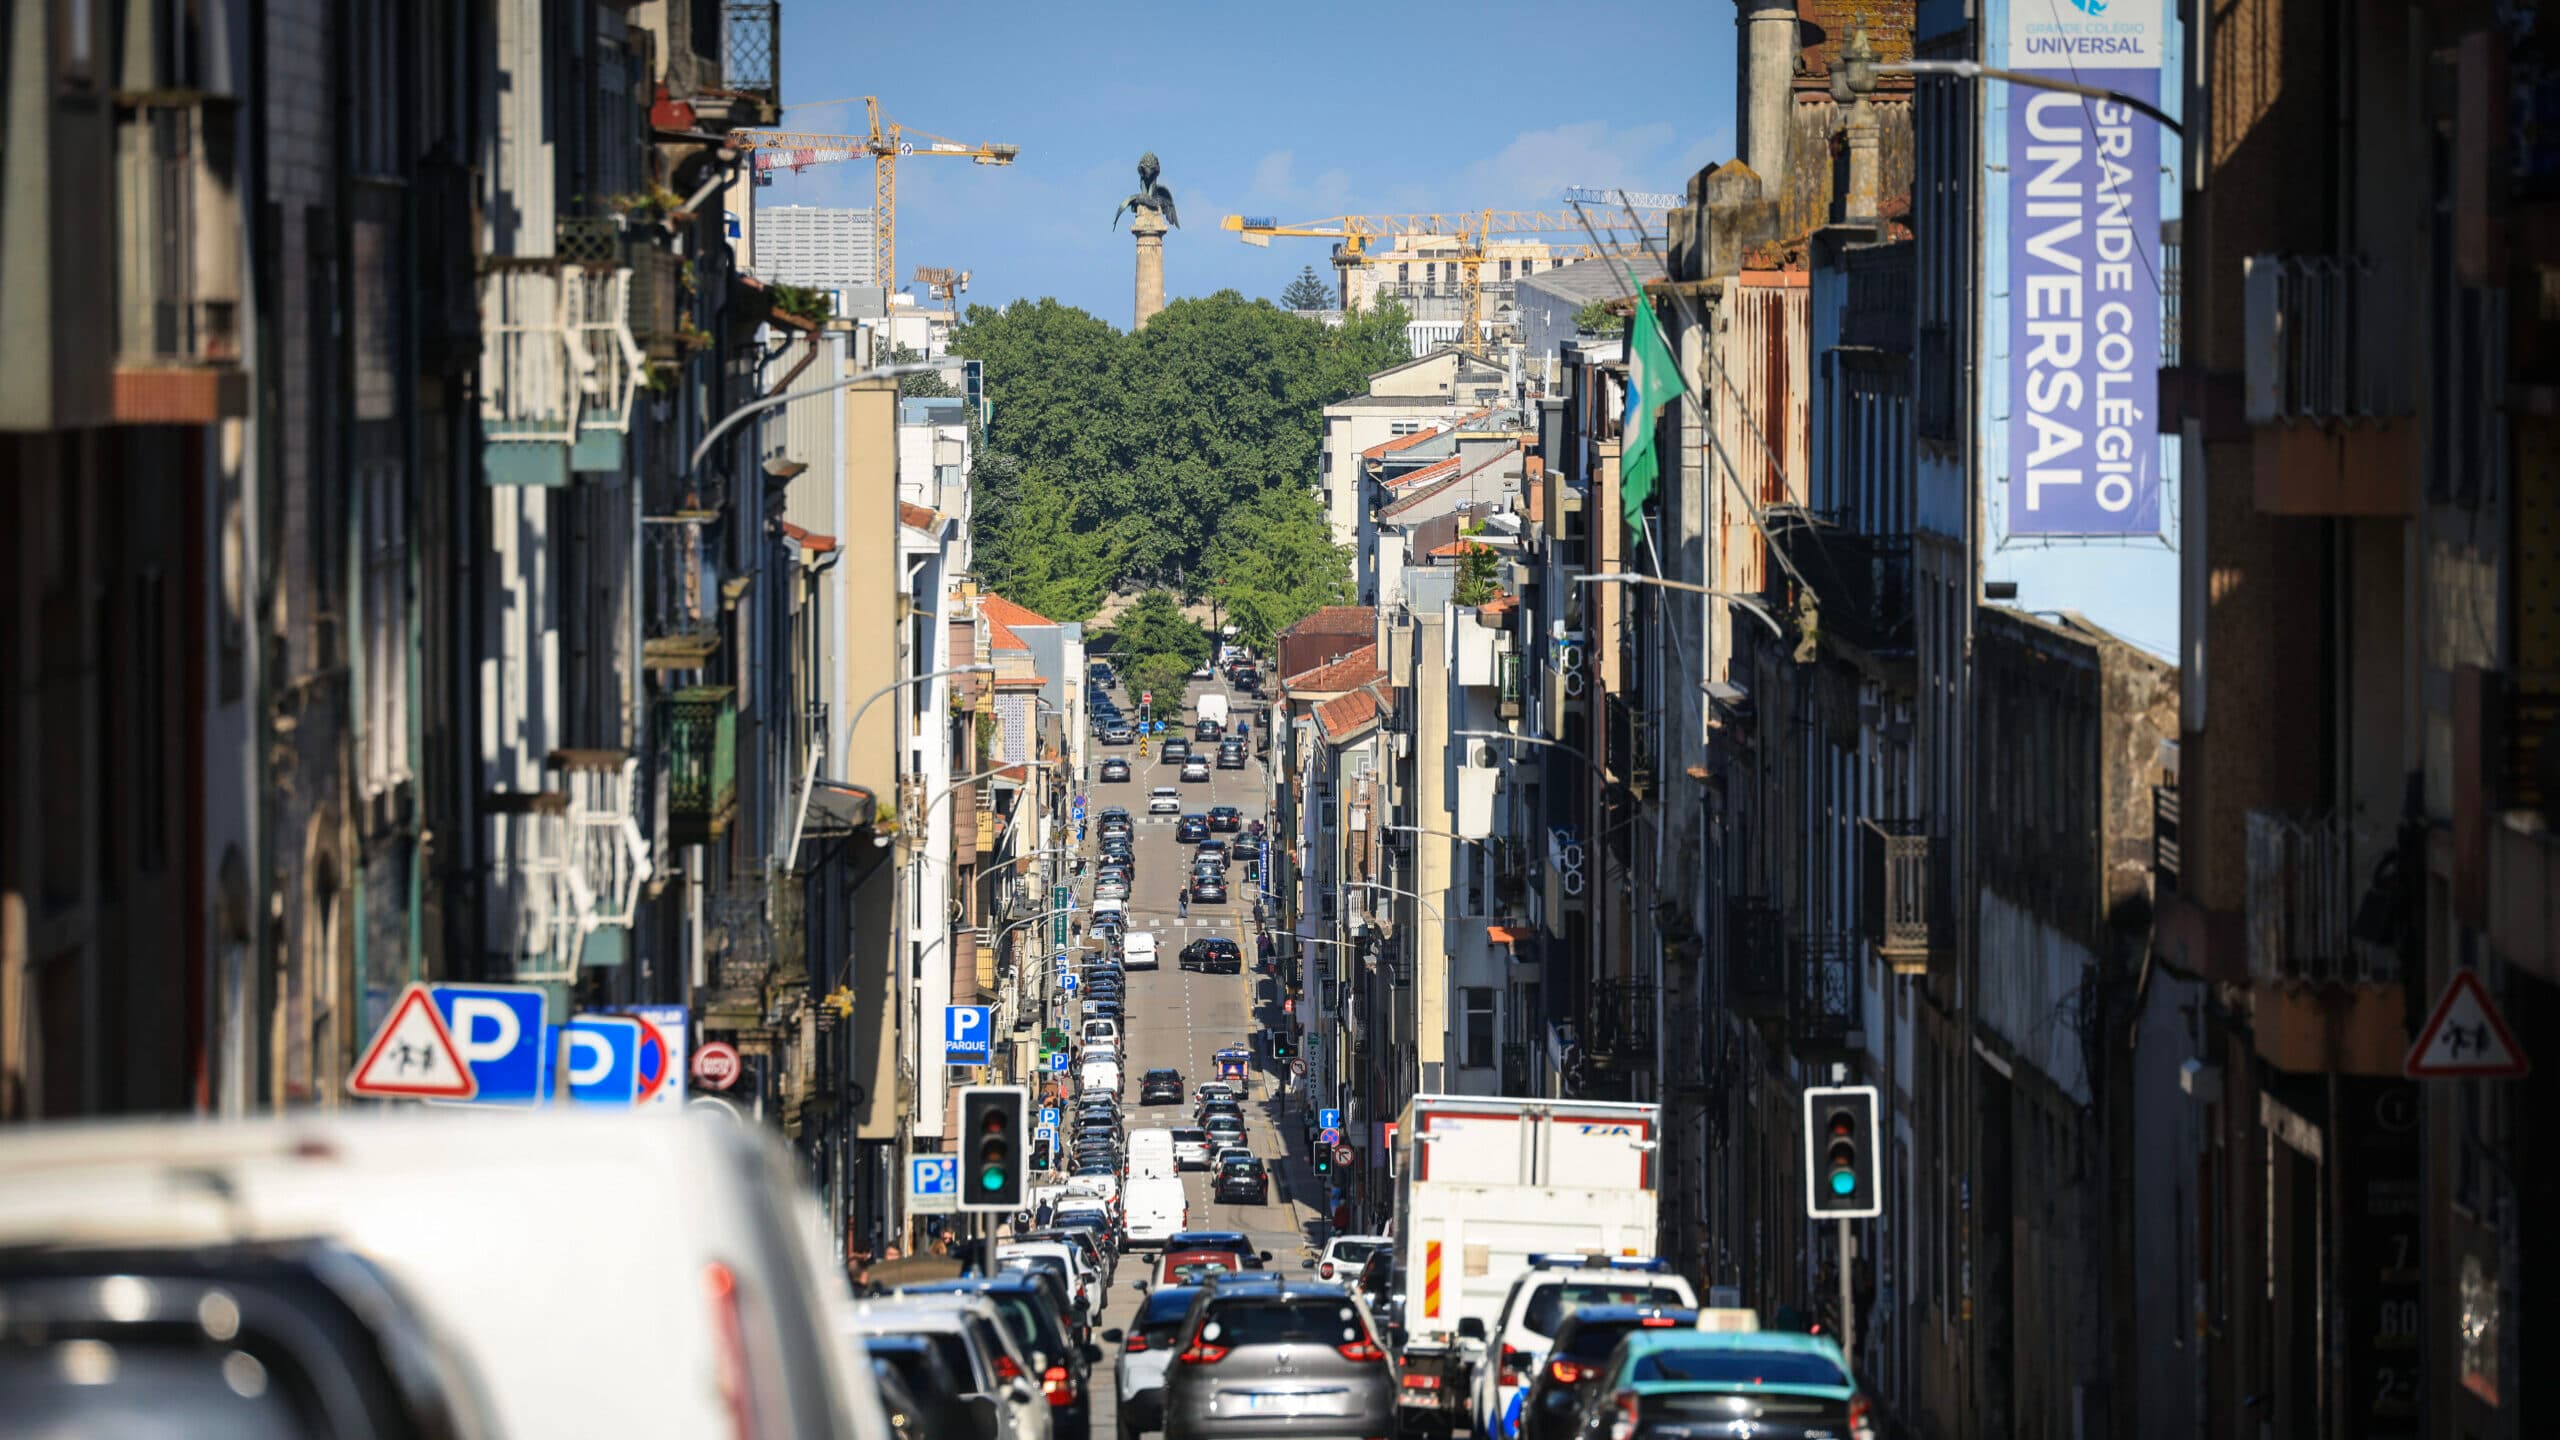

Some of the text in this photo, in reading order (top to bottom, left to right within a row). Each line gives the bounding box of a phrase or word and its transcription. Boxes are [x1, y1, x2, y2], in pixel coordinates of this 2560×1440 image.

[2025, 21, 2144, 34] GRANDE COLÉGIO
[2026, 37, 2145, 54] UNIVERSAL
[2025, 92, 2084, 512] UNIVERSAL
[2095, 98, 2144, 512] GRANDE COLÉGIO
[1064, 977, 1073, 987] P
[452, 996, 521, 1063] P
[954, 1008, 980, 1040] P
[946, 1040, 986, 1051] PARQUE
[1055, 1056, 1064, 1068] P
[1044, 1111, 1055, 1122] P
[917, 1162, 941, 1192] P
